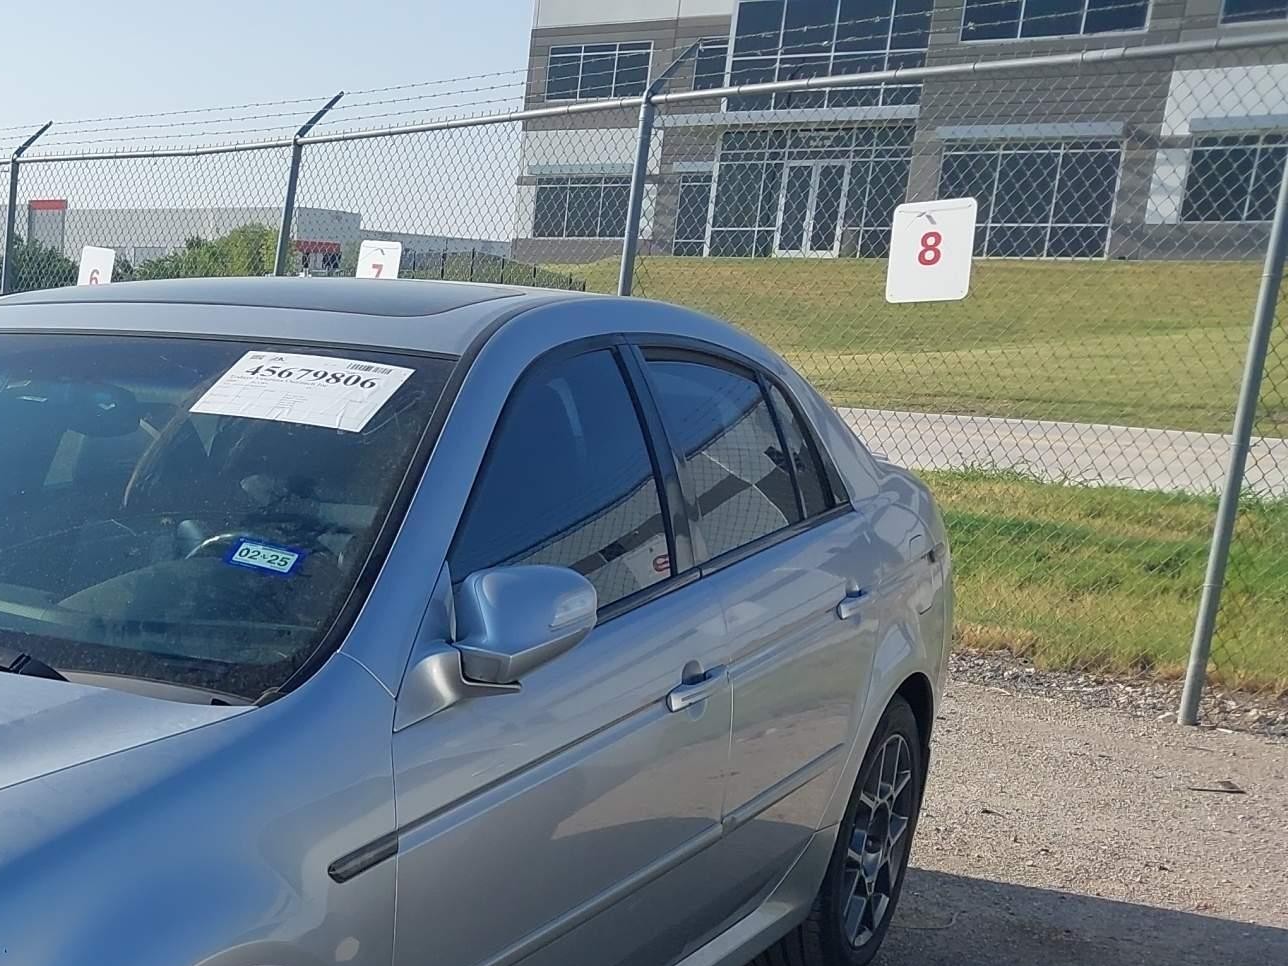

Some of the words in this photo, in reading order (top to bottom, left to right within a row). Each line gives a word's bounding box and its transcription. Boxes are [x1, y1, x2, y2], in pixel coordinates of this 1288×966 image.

[918, 231, 942, 266] 8
[371, 263, 384, 279] 7
[245, 364, 381, 390] 45679806
